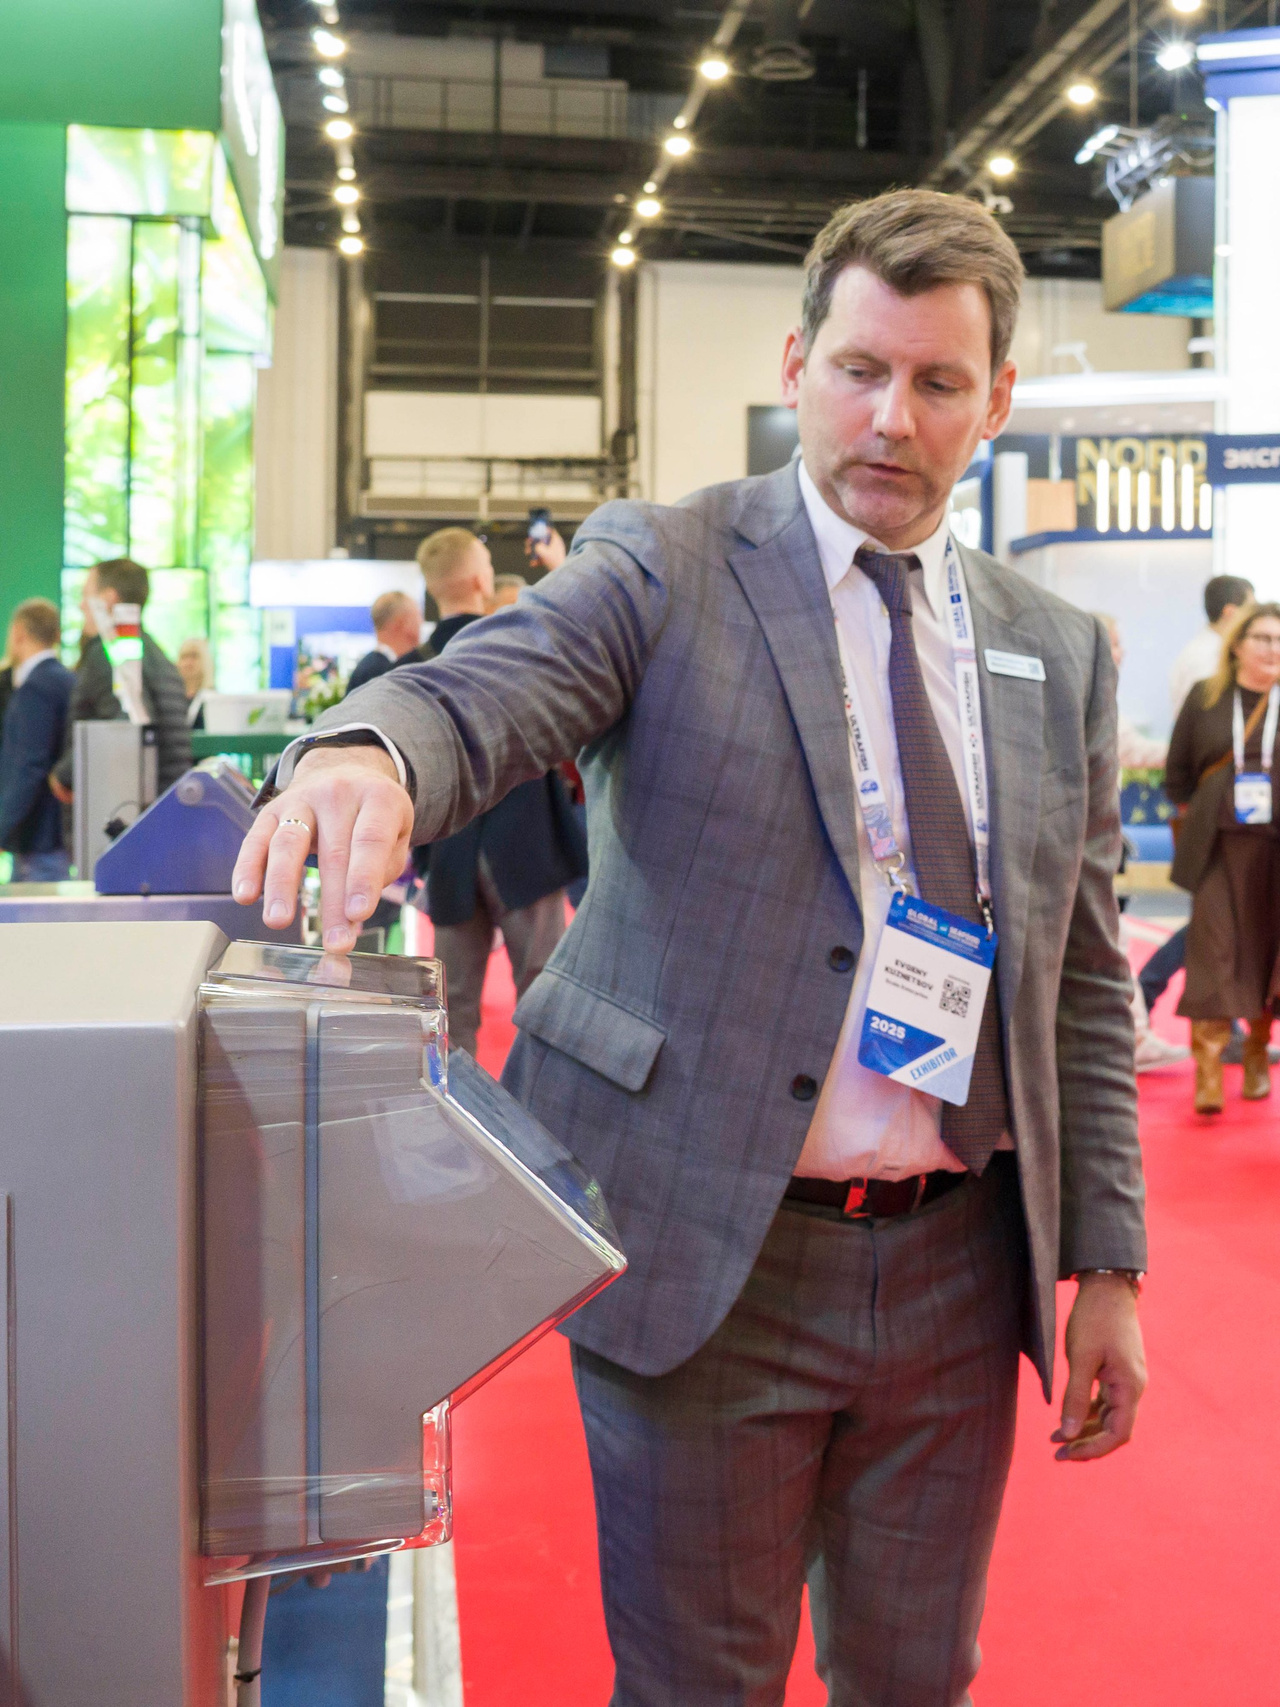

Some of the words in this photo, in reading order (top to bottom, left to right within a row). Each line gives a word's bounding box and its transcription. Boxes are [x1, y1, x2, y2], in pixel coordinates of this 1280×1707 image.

[849, 714, 869, 771] ULTRAFISH
[870, 1016, 906, 1040] 2025
[911, 1047, 958, 1080] EXHIBITOR
